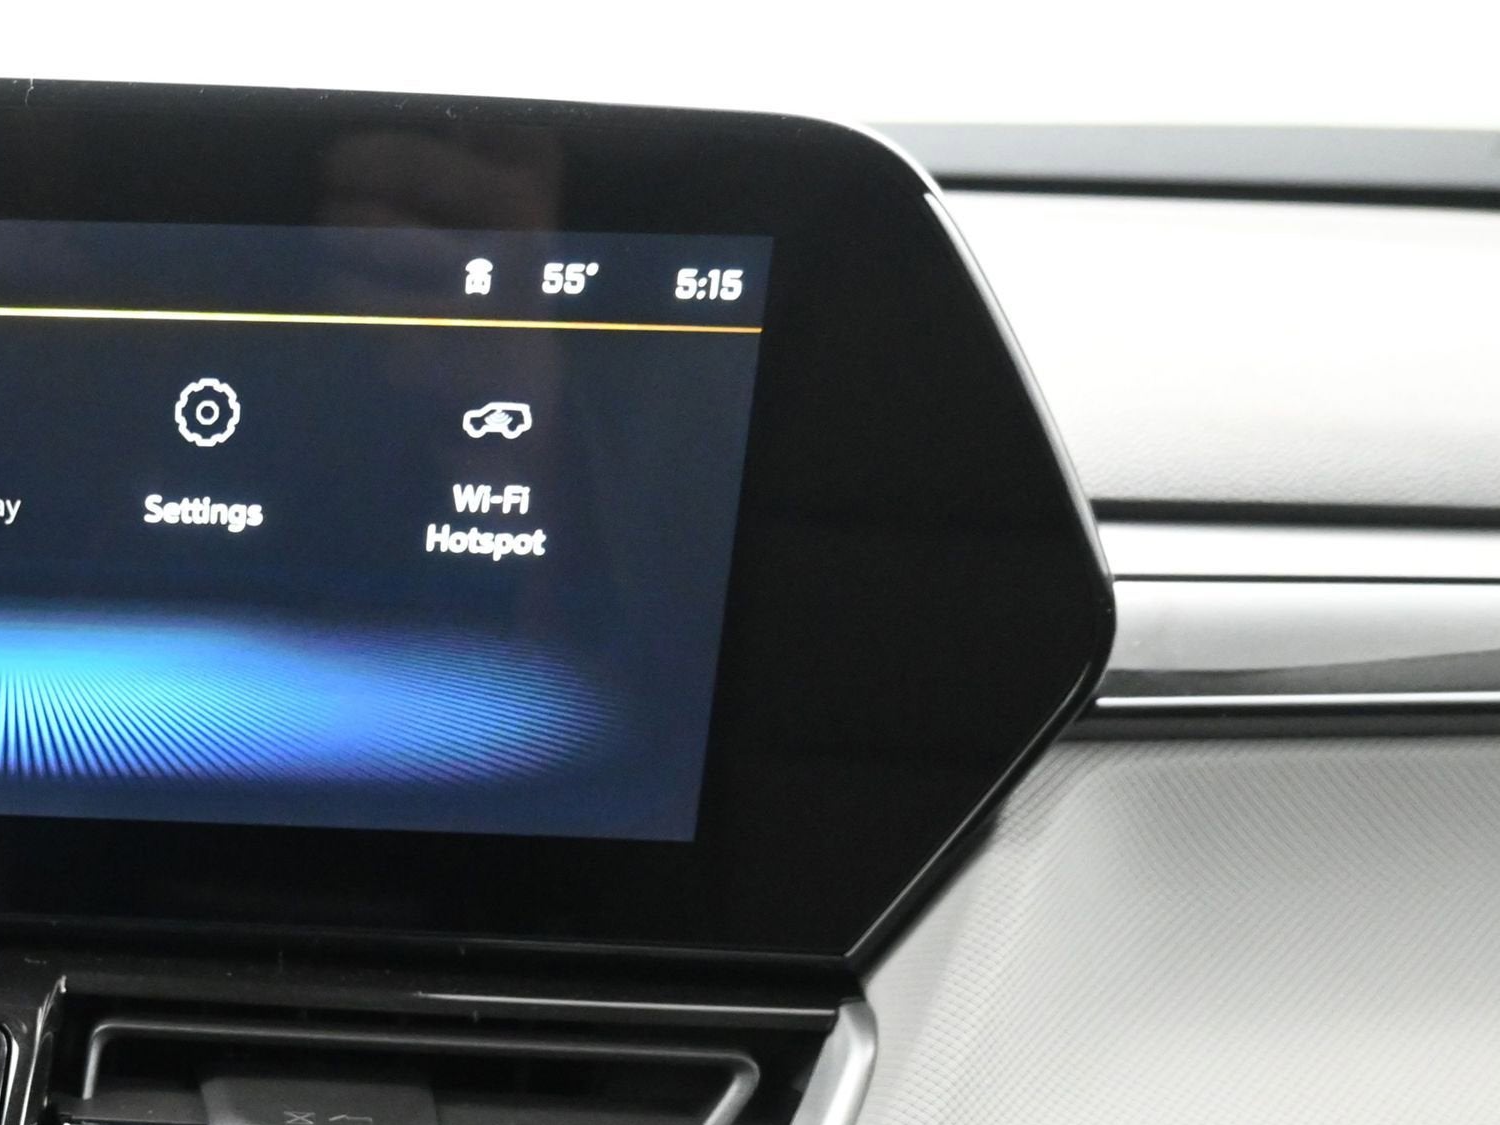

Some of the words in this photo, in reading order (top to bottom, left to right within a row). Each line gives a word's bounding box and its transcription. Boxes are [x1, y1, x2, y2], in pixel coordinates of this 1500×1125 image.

[541, 260, 599, 296] 55°
[674, 266, 744, 302] 5:15
[143, 494, 264, 534] Settings
[451, 483, 531, 517] Wi-Fi
[425, 524, 548, 561] Hotspot
